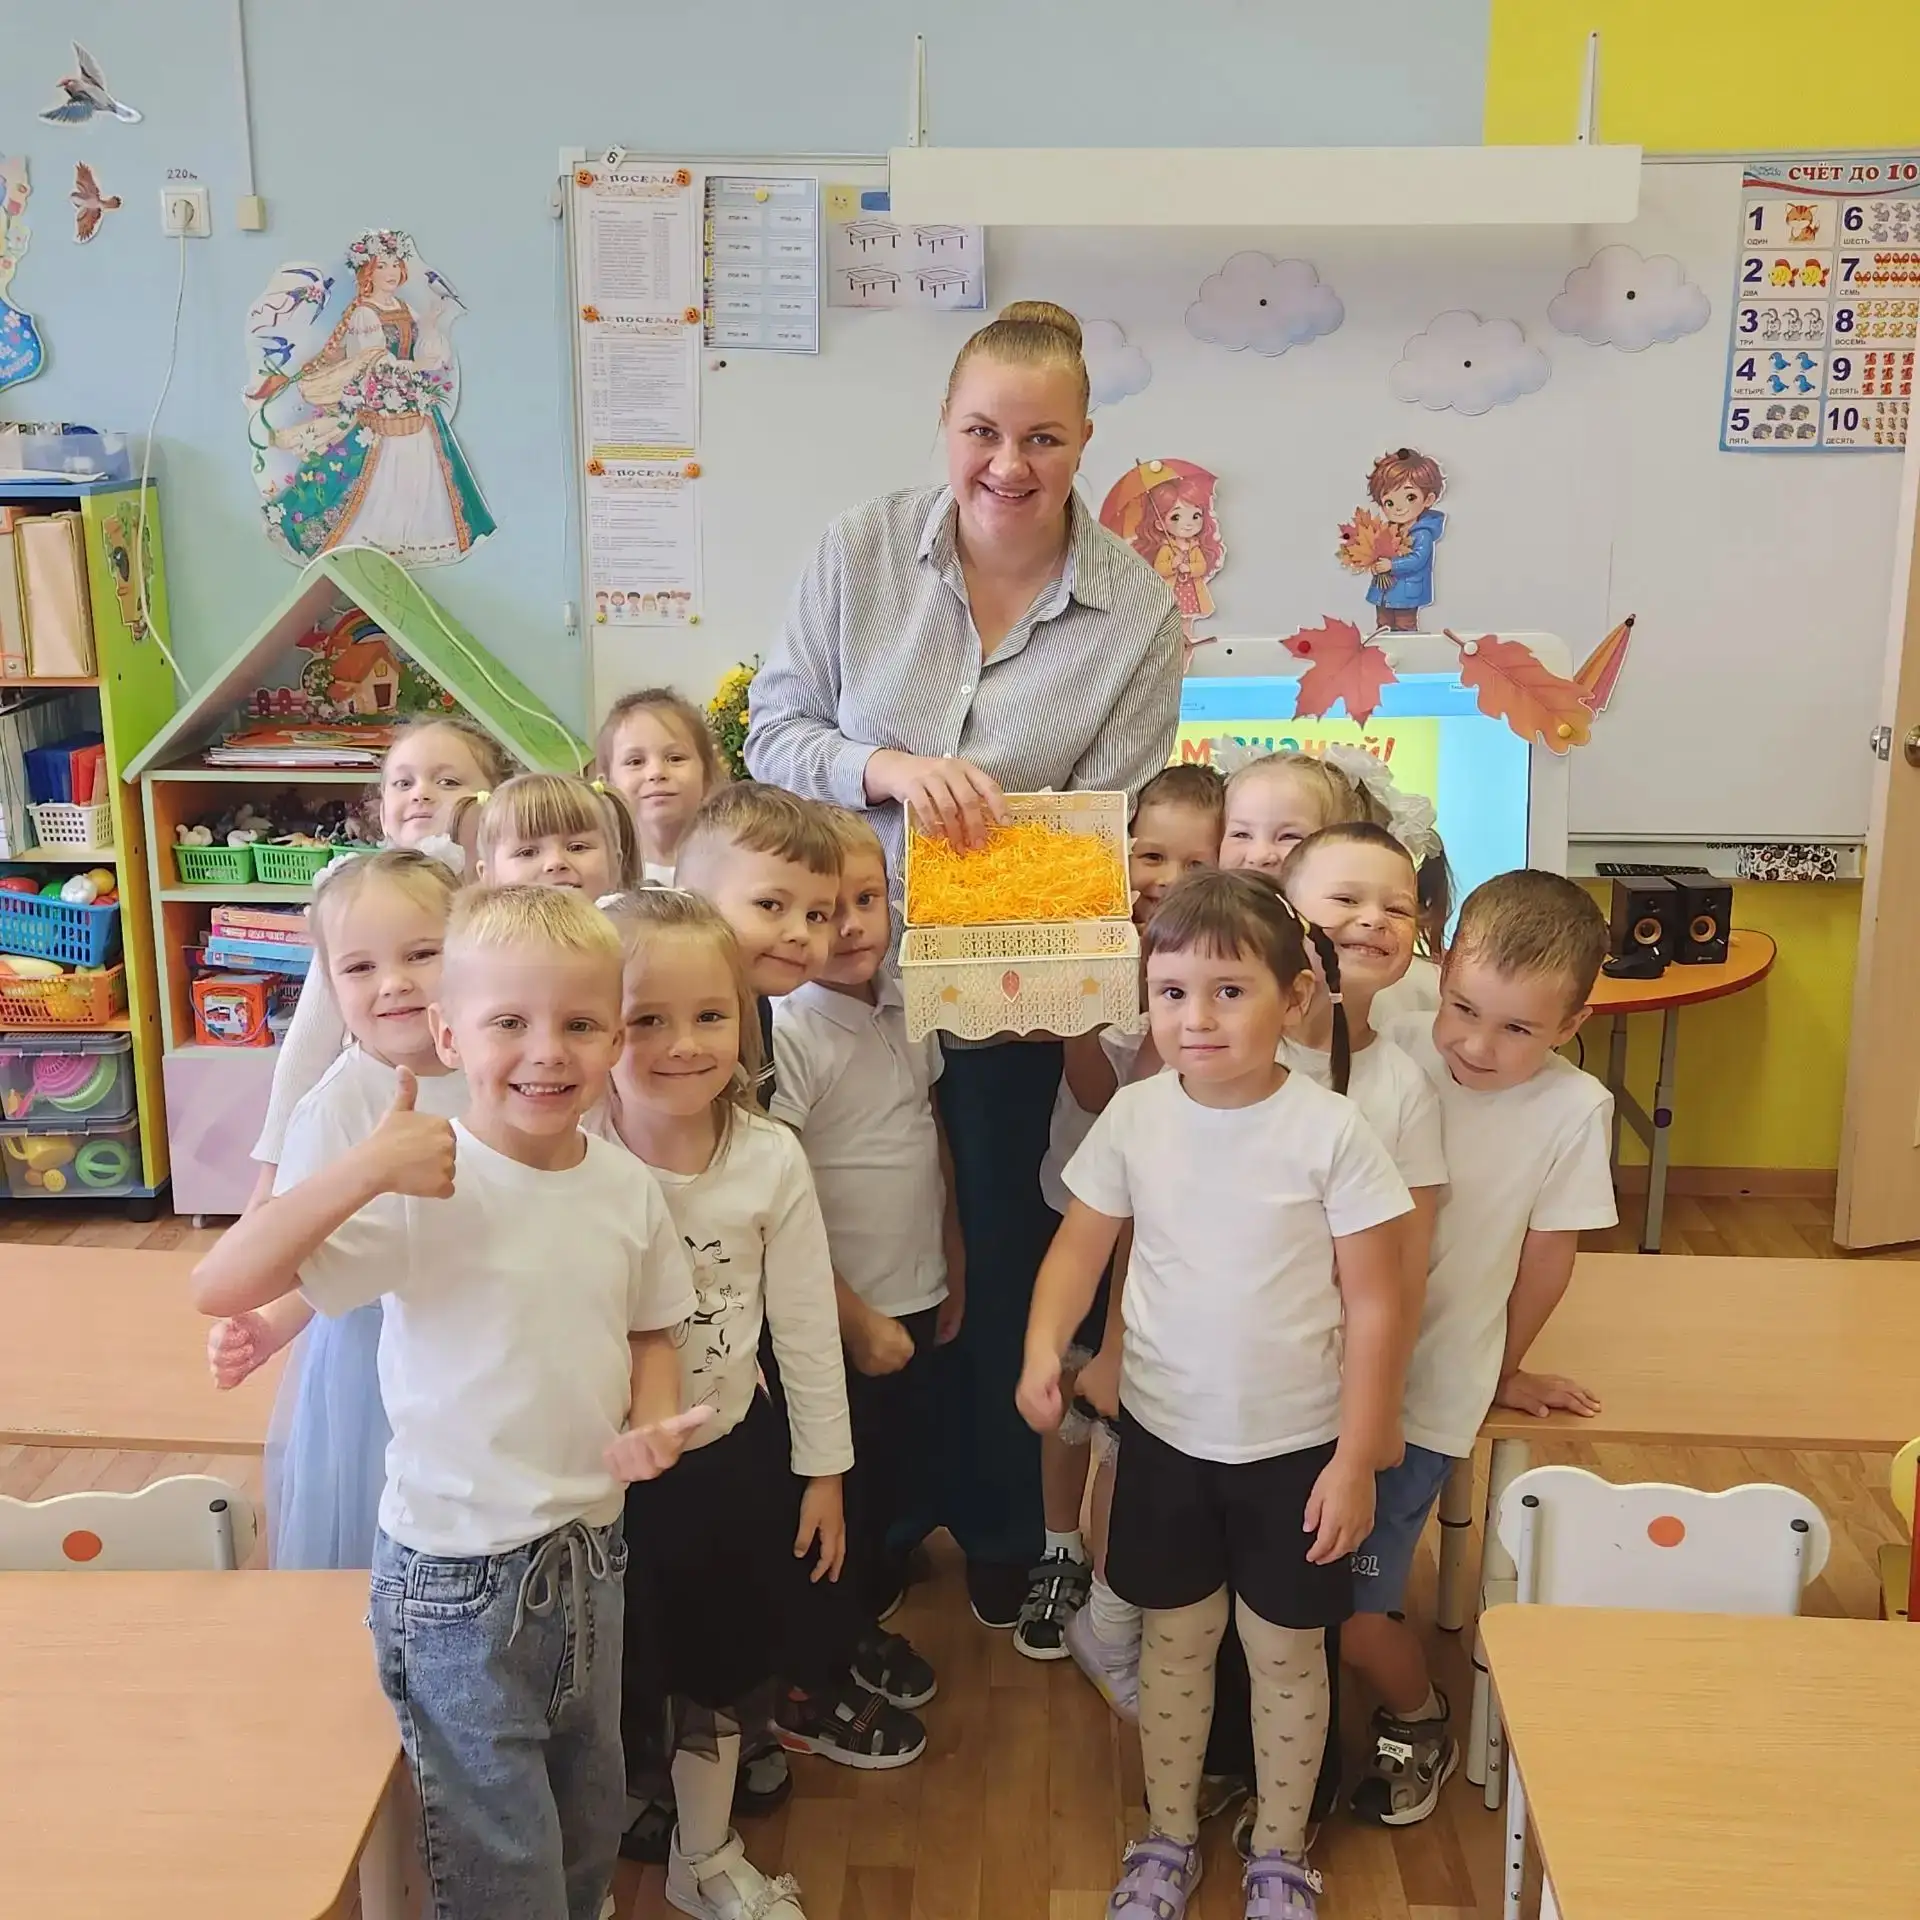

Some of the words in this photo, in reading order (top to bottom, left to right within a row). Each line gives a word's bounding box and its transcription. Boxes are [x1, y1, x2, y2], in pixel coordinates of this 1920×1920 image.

[607, 151, 618, 164] 6
[1788, 162, 1844, 181] СЧЁТ
[1848, 166, 1880, 183] ДО
[1887, 164, 1918, 180] 10
[1748, 206, 1764, 231] 1
[1844, 206, 1863, 231] 6
[1742, 258, 1763, 283] 2
[1841, 258, 1860, 282] 7
[1739, 309, 1759, 333] 3
[1835, 309, 1854, 333] 8
[1736, 357, 1757, 381] 4
[1832, 357, 1851, 382] 9
[1829, 388, 1859, 396] ДЕВЯТЬ
[1730, 408, 1750, 432] 5
[1828, 407, 1859, 431] 10
[1826, 437, 1855, 445] ДЕСЯТЬ
